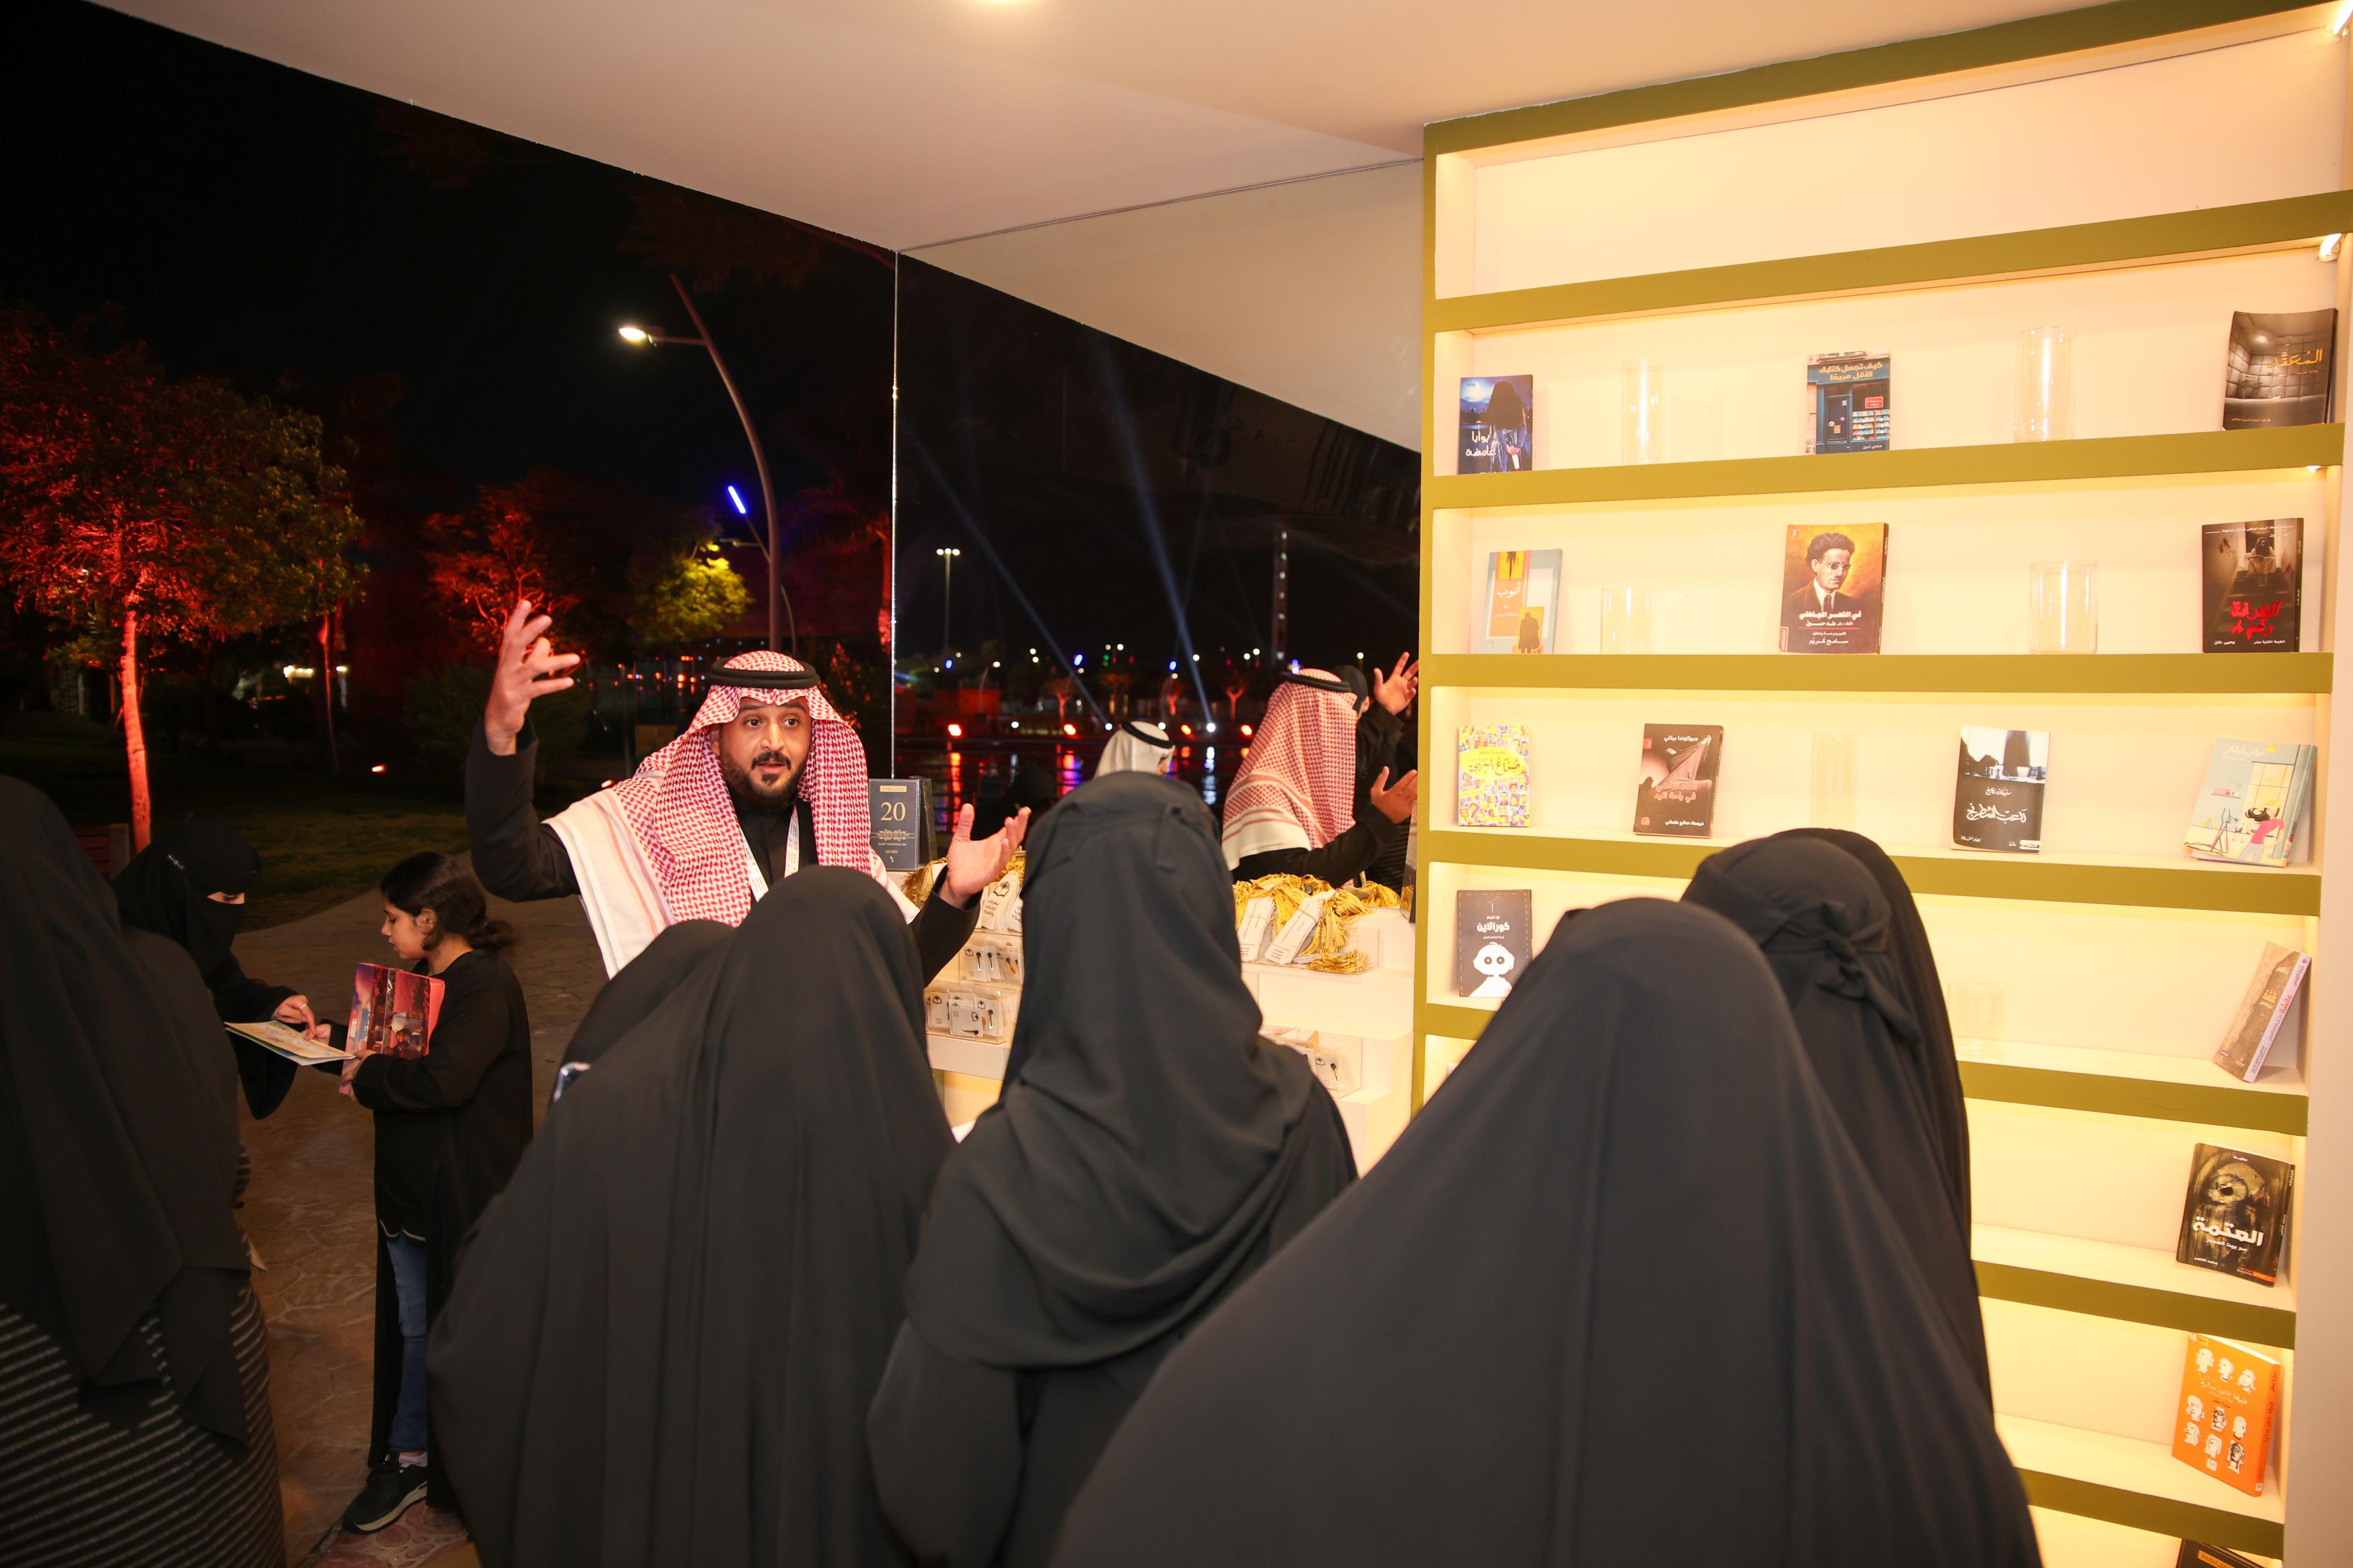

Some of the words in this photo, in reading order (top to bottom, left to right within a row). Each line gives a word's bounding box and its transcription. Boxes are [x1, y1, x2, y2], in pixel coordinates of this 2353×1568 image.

[1819, 365, 1841, 374] كتابك
[1841, 363, 1864, 373] تجعل
[1864, 361, 1883, 370] كيف
[1466, 445, 1496, 457] غامضة
[1496, 581, 1520, 598] أنبوب
[1799, 610, 1828, 620] الجاهلي
[1851, 610, 1862, 620] في
[2230, 599, 2283, 620] الغرفة
[1828, 611, 1851, 620] الشعر
[2245, 617, 2274, 641] رقم
[1654, 791, 1668, 801] اليد
[1669, 792, 1684, 801] راحة
[1685, 792, 1697, 804] في
[880, 801, 906, 821] 20
[1477, 921, 1510, 933] كورالاين
[2281, 995, 2292, 1013] عائشة
[2192, 1216, 2265, 1247] العتمة
[2205, 1238, 2225, 1247] العجوز
